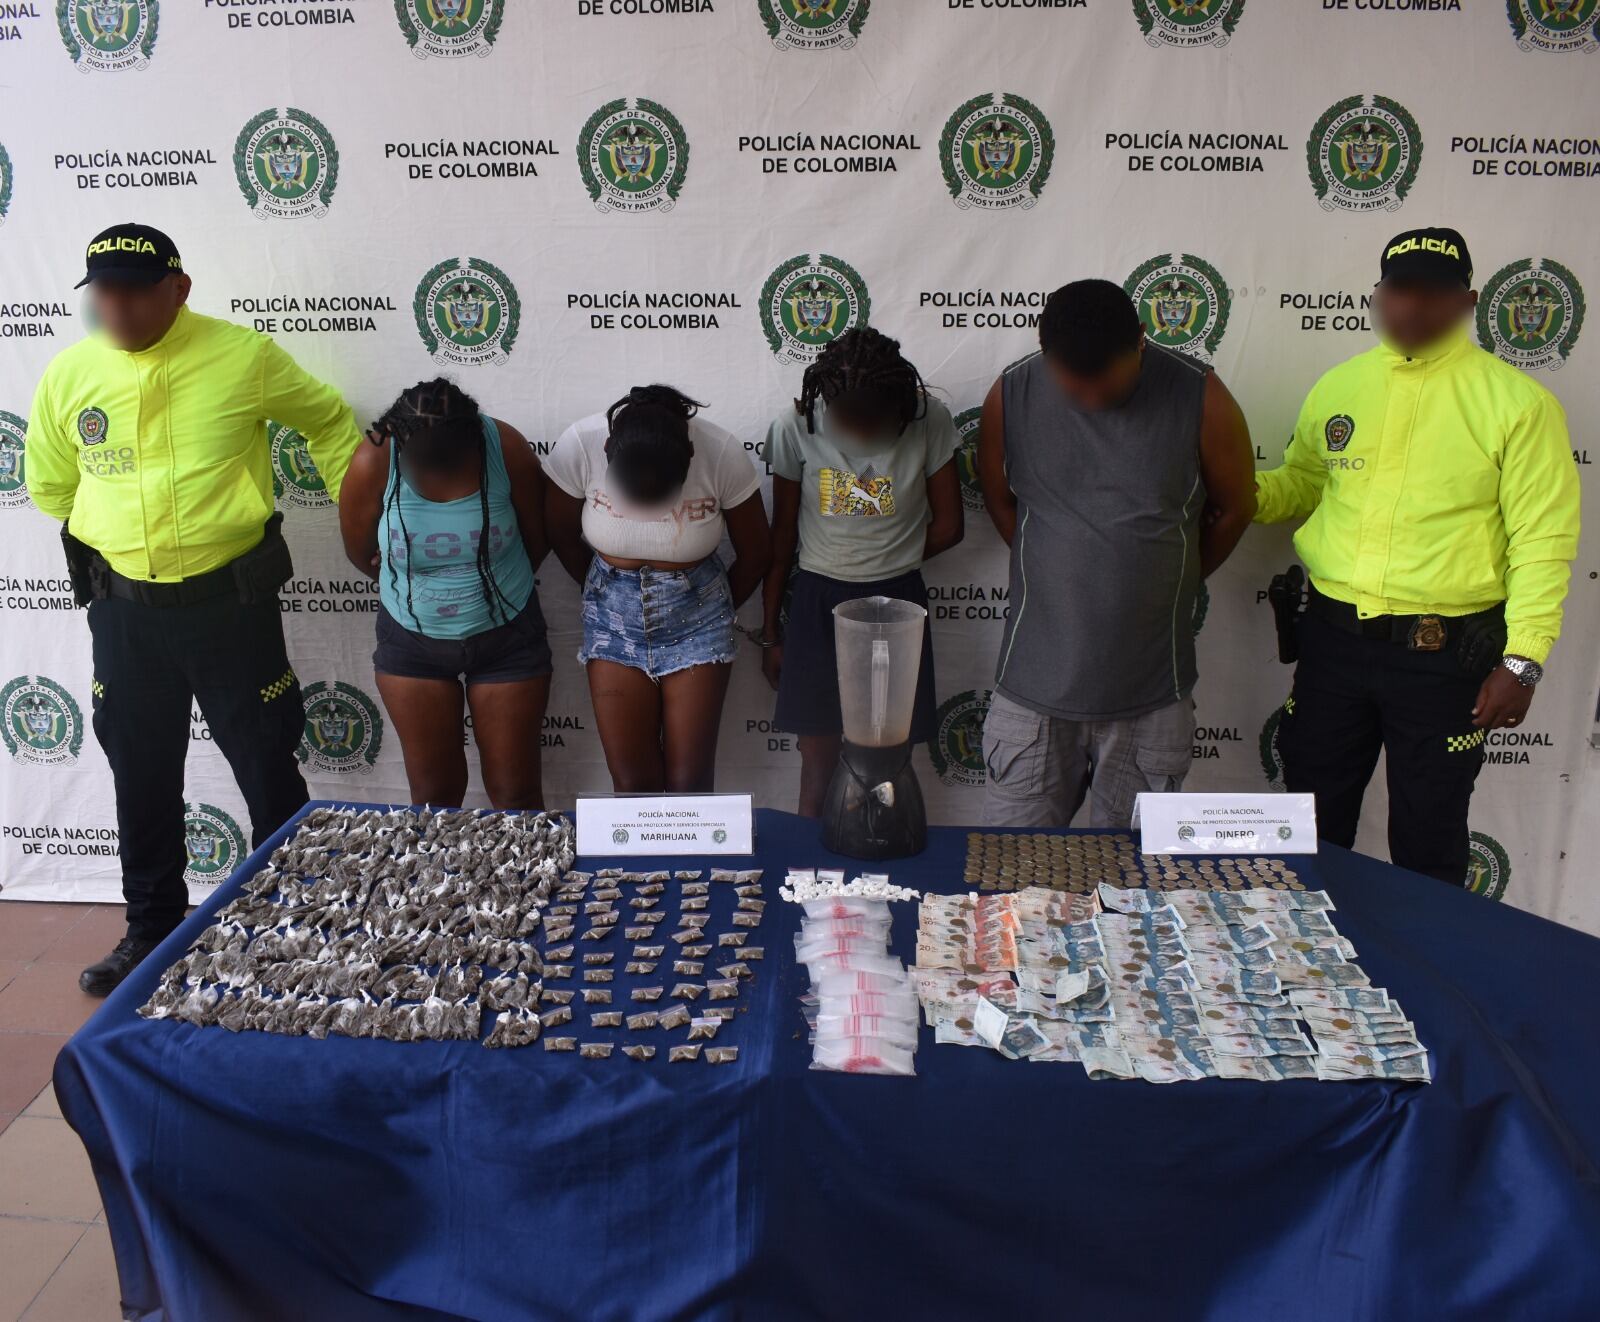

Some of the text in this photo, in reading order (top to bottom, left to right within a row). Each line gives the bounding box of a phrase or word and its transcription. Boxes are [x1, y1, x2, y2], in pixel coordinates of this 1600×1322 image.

[578, 0, 714, 15] DE COLOMBIA
[228, 9, 354, 28] DE COLOMBIA
[775, 7, 854, 36] POLICIA NACIONAL
[785, 33, 806, 46] DIOS
[815, 34, 844, 47] PATRIA
[591, 115, 618, 163] REPUBLICA
[648, 116, 675, 161] COLOMBIA
[739, 132, 920, 151] POLICÍA NACIONAL
[954, 111, 984, 159] REPUBLICA
[1014, 111, 1040, 158] COLOMBIA
[1106, 130, 1288, 149] POLICÍA NACIONAL
[1321, 112, 1353, 159] REPUBLICA
[1384, 114, 1408, 160] COLOMBIA
[247, 125, 270, 171] REPUBLICA
[298, 125, 326, 169] COLOMBIA
[385, 139, 559, 158] POLICÍA NACIONAL
[1452, 135, 1527, 153] POLICÍA
[55, 150, 216, 168] POLICÍA NACIONAL
[763, 157, 896, 173] DE COLOMBIA
[1129, 156, 1263, 171] DE COLOMBIA
[409, 162, 537, 178] DE COLOMBIA
[1473, 160, 1600, 176] DE COLOMBIA
[77, 171, 197, 188] DE COLOMBIA
[596, 172, 672, 199] POLICIA NACIONAL
[958, 168, 1035, 196] POLICIA NACIONAL
[1325, 171, 1402, 198] POLICIA NACIONAL
[253, 178, 324, 206] POLICIA NACIONAL
[966, 193, 987, 206] DIOS
[995, 194, 1025, 206] PATRIA
[263, 204, 282, 216] DIOS
[290, 203, 317, 216] PATRIA
[606, 197, 626, 208] DIOS
[635, 197, 663, 210] PATRIA
[1332, 195, 1352, 208] DIOS
[1361, 196, 1390, 209] PATRIA
[87, 237, 157, 258] POLICÍA
[1386, 237, 1459, 260] POLICÍA
[427, 274, 452, 318] REPUBLICA
[480, 274, 508, 317] COLOMBIA
[568, 291, 741, 308] POLICÍA NACIONAL
[773, 271, 801, 316] REPUBLICA
[830, 271, 856, 316] COLOMBIA
[920, 289, 995, 306] POLICÍA
[1280, 291, 1354, 309] POLICÍA
[1490, 275, 1521, 320] REPUBLICA
[1550, 276, 1571, 321] COLOMBIA
[231, 295, 396, 312] POLICÍA NACIONAL
[254, 317, 376, 332] DE COLOMBIA
[591, 315, 719, 328] DE COLOMBIA
[943, 314, 967, 327] DE
[1302, 316, 1326, 330] DE
[3, 323, 54, 337] OMBIA
[778, 326, 805, 350] POLICIA
[433, 328, 505, 353] POLICIA NACIONAL
[1492, 331, 1565, 357] POLICIA NACIONAL
[443, 350, 462, 362] DIOS
[470, 350, 497, 363] PATRIA
[787, 349, 806, 361] DIOS
[1526, 355, 1554, 367] PATRIA
[281, 600, 302, 612] DE
[936, 606, 959, 619] DE
[768, 739, 790, 751] DE
[638, 810, 664, 818] POLICÍA
[1203, 808, 1229, 816] POLICÍA
[4, 825, 60, 838] POLICÍA
[640, 832, 697, 841] MARIHUANA
[1215, 830, 1255, 840] DINERO
[22, 843, 42, 854] DE
